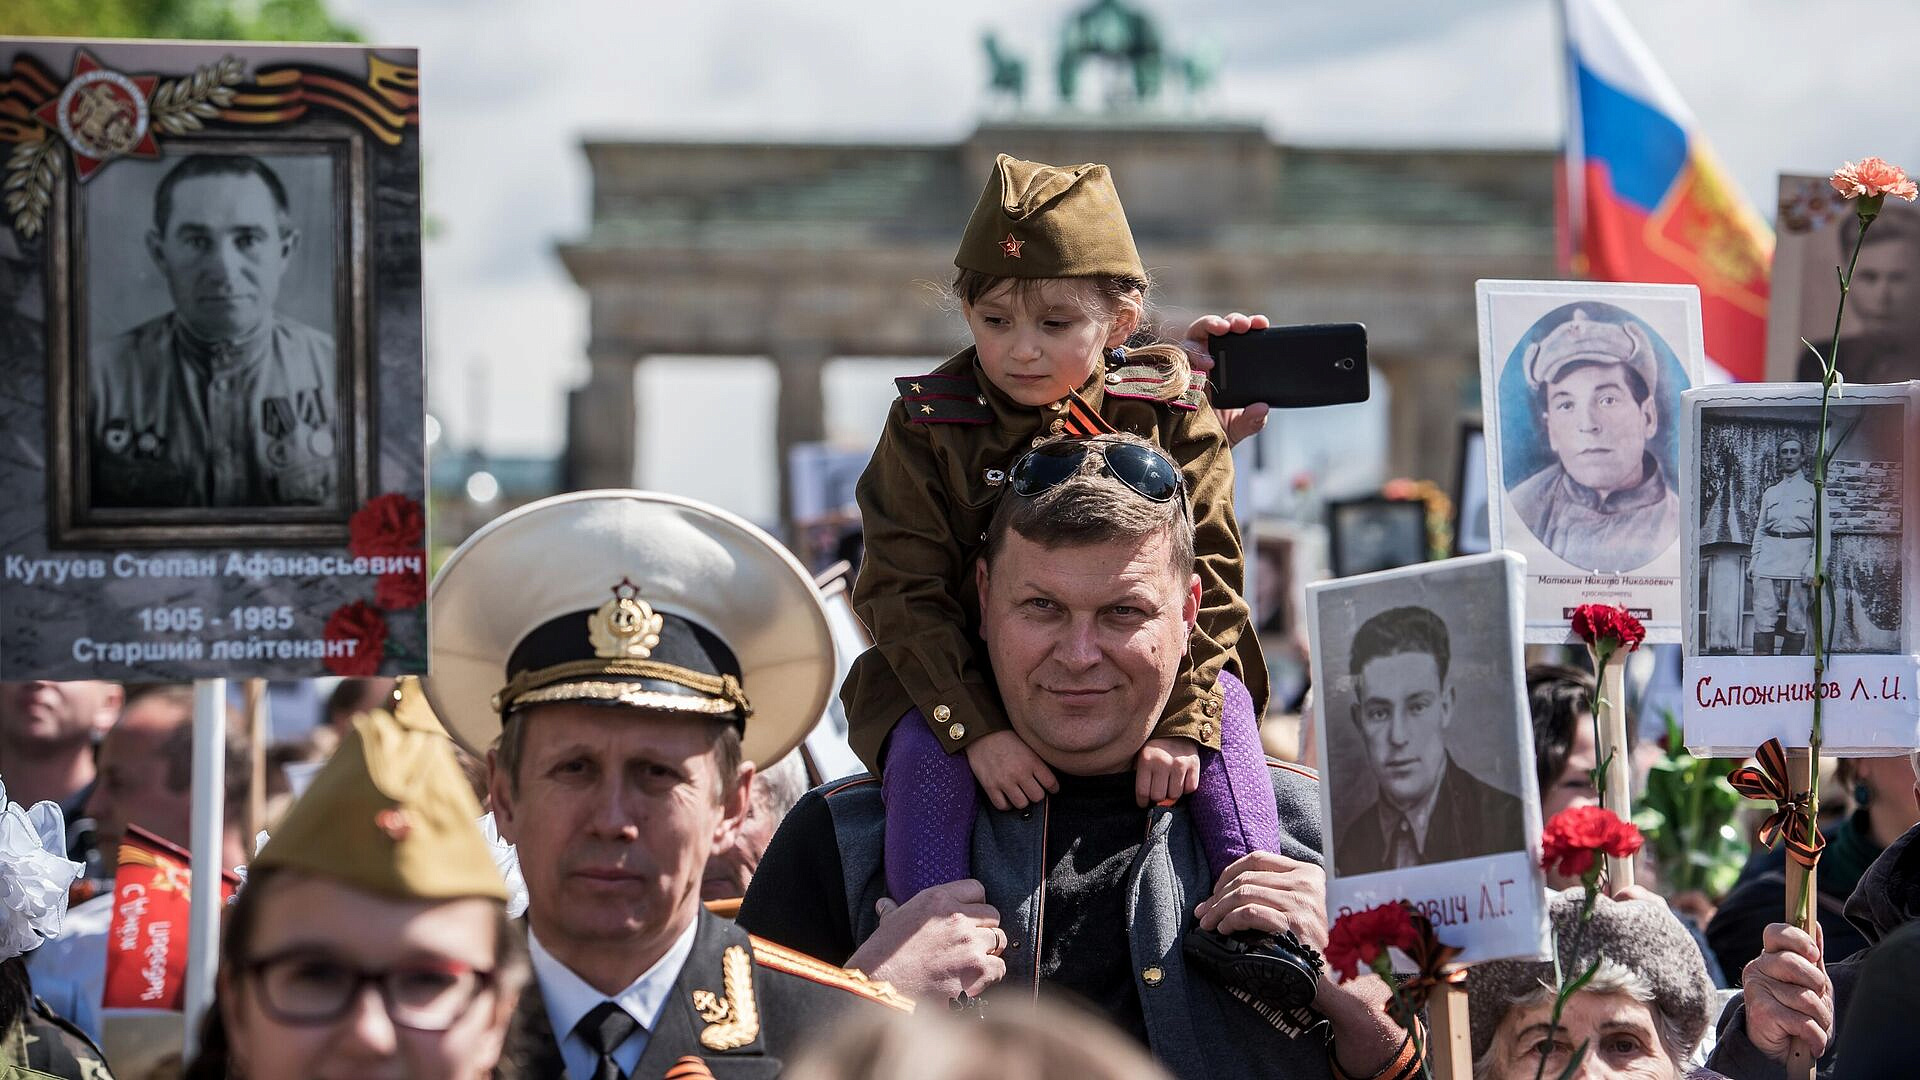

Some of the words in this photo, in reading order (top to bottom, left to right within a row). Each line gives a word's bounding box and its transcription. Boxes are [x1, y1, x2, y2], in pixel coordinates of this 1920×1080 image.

[5, 554, 106, 585] Кутуев
[113, 553, 217, 578] Степан
[223, 552, 421, 581] Афанасьевич
[1622, 577, 1674, 586] Николаевич
[138, 607, 204, 632] 1905
[229, 606, 295, 631] 1985
[72, 636, 203, 667] Старший
[211, 635, 359, 660] лейтенант
